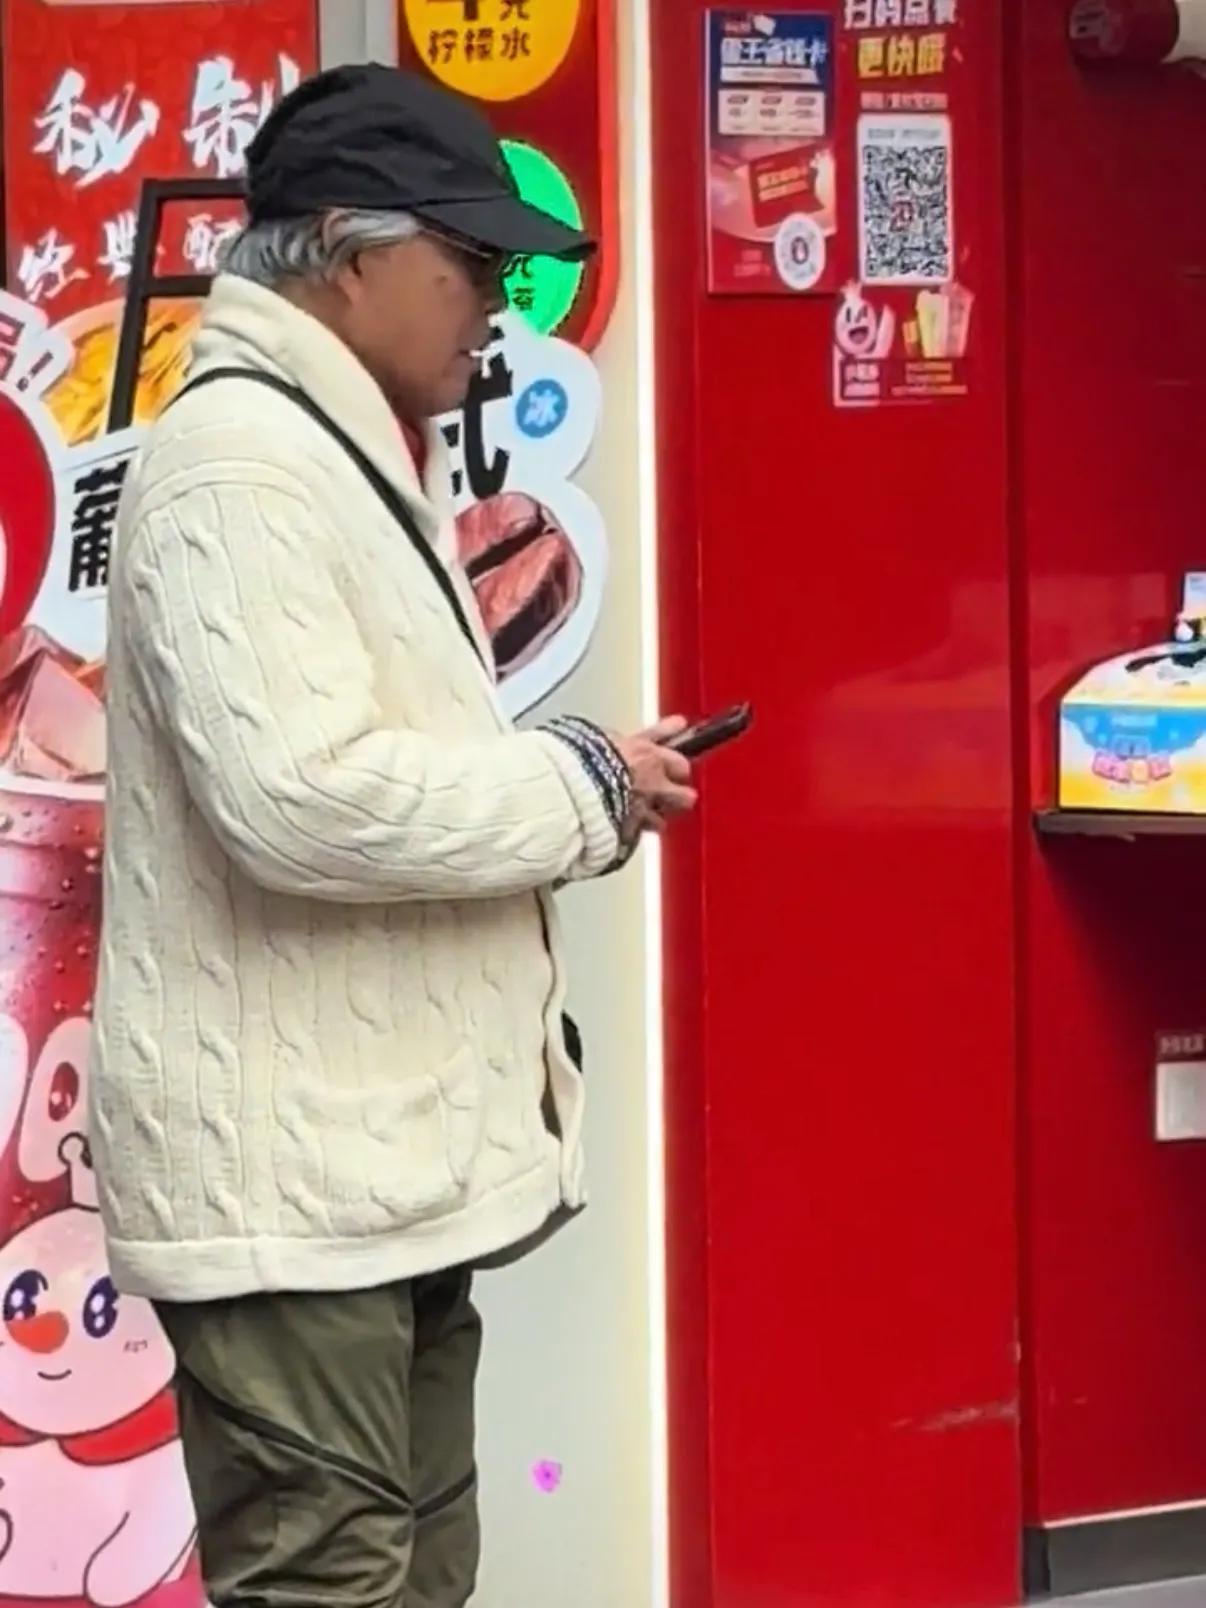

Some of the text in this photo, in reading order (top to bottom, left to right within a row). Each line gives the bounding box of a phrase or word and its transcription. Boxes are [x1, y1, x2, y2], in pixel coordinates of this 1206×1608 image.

[428, 27, 531, 64] 柠檬水
[33, 53, 300, 190] 秘制
